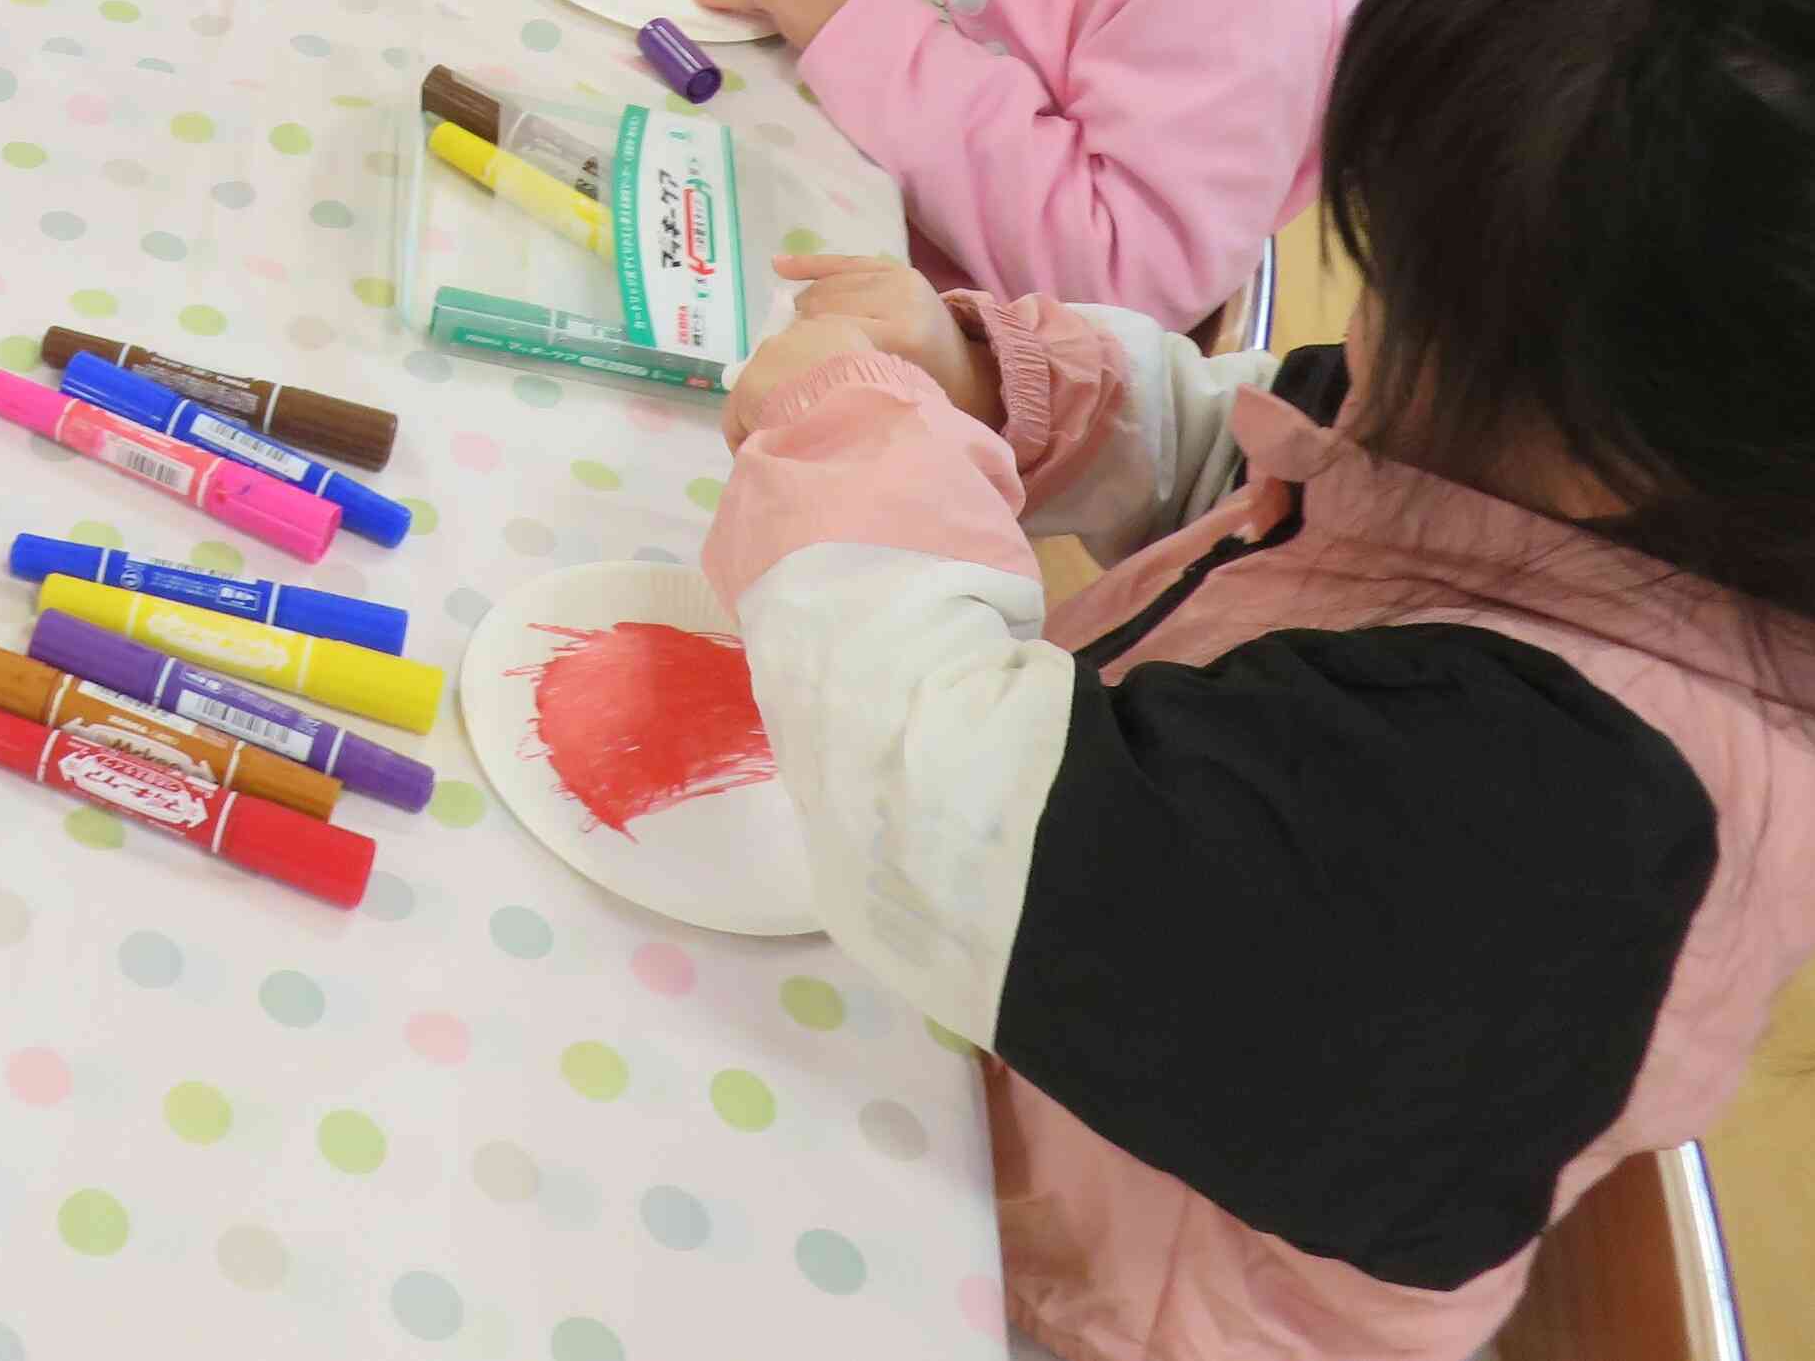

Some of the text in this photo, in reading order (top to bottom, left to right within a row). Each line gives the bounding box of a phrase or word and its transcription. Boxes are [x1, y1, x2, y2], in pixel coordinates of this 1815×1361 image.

[658, 169, 682, 269] マッキーケア
